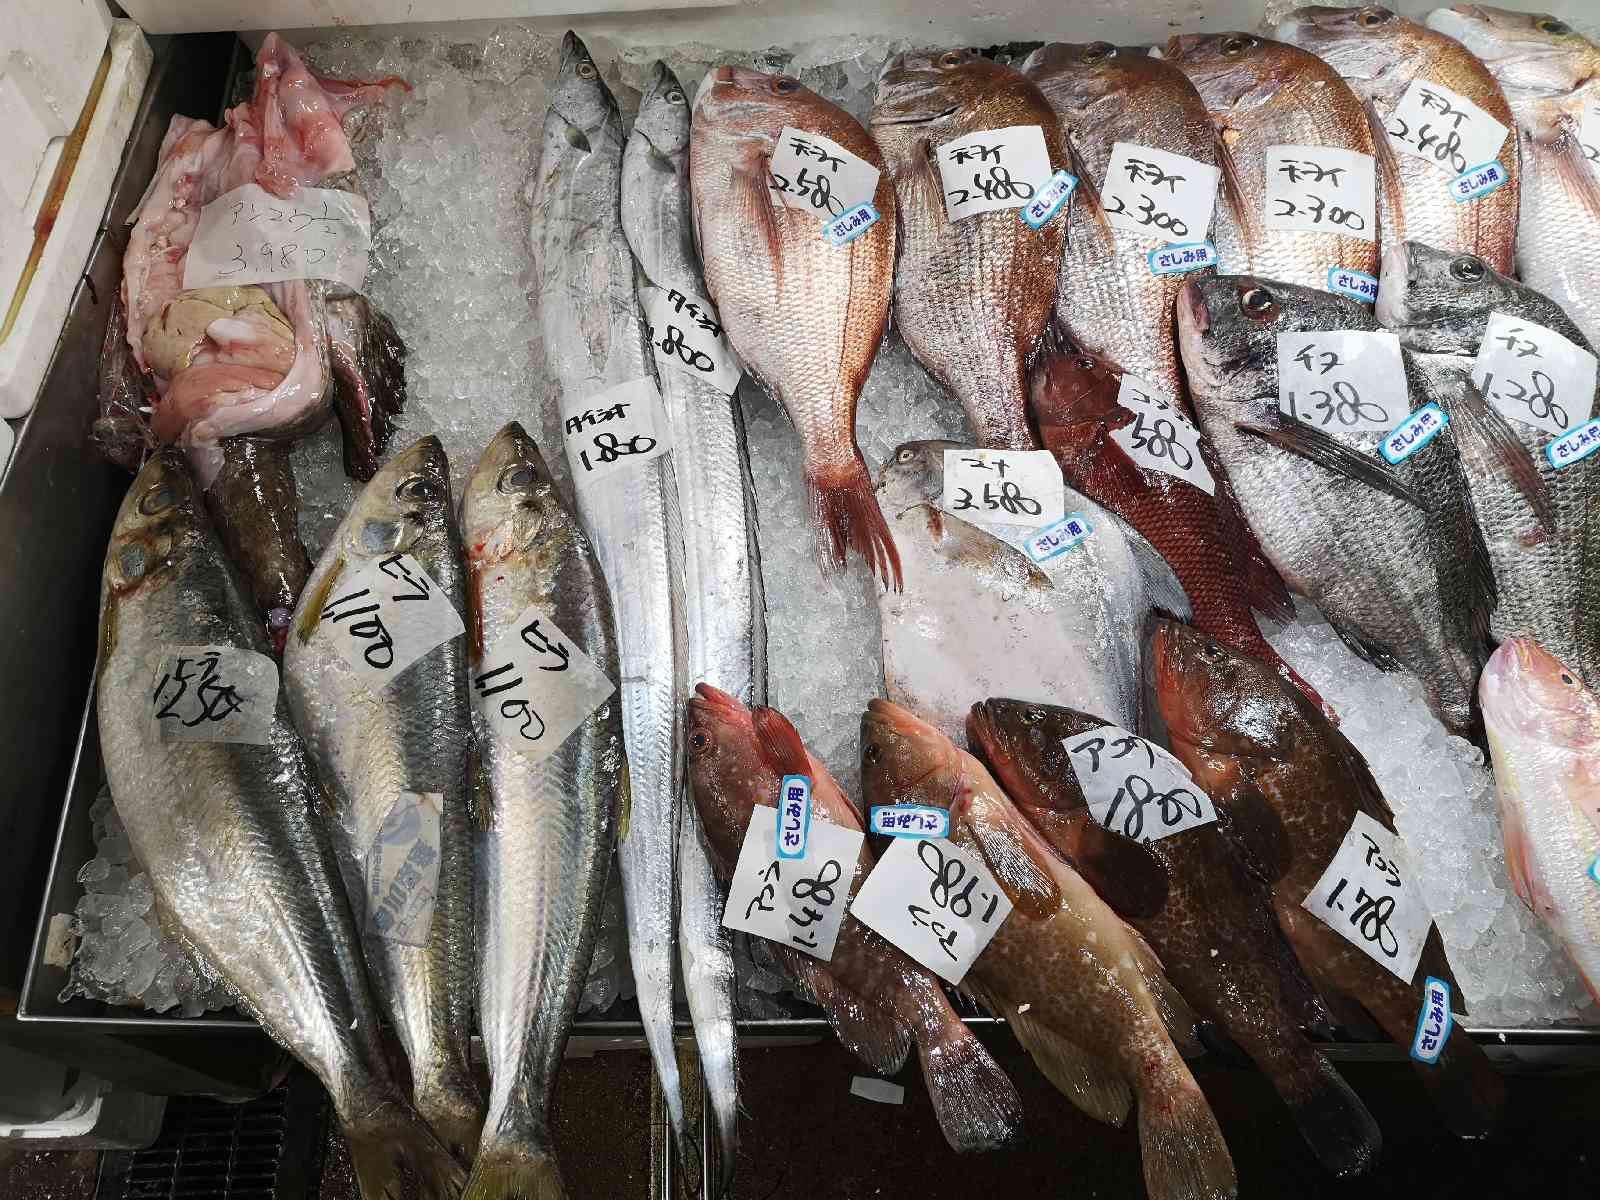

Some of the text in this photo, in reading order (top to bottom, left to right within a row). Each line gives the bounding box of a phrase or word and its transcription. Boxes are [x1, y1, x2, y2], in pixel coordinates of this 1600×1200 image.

[1457, 167, 1500, 194] さしみ用
[1031, 181, 1069, 219] さしみ用
[833, 207, 872, 238] さしみ用
[1158, 247, 1208, 267] さしみ用
[1288, 380, 1389, 426] 1.380
[1481, 370, 1569, 430] 1.280
[1389, 412, 1438, 452] さしみ用
[1556, 425, 1600, 458] さしみ用
[1035, 520, 1083, 552] さしみ用
[784, 786, 804, 846] さしみ用
[881, 811, 938, 831] さしみ用
[1421, 989, 1445, 1051] さしみ用
